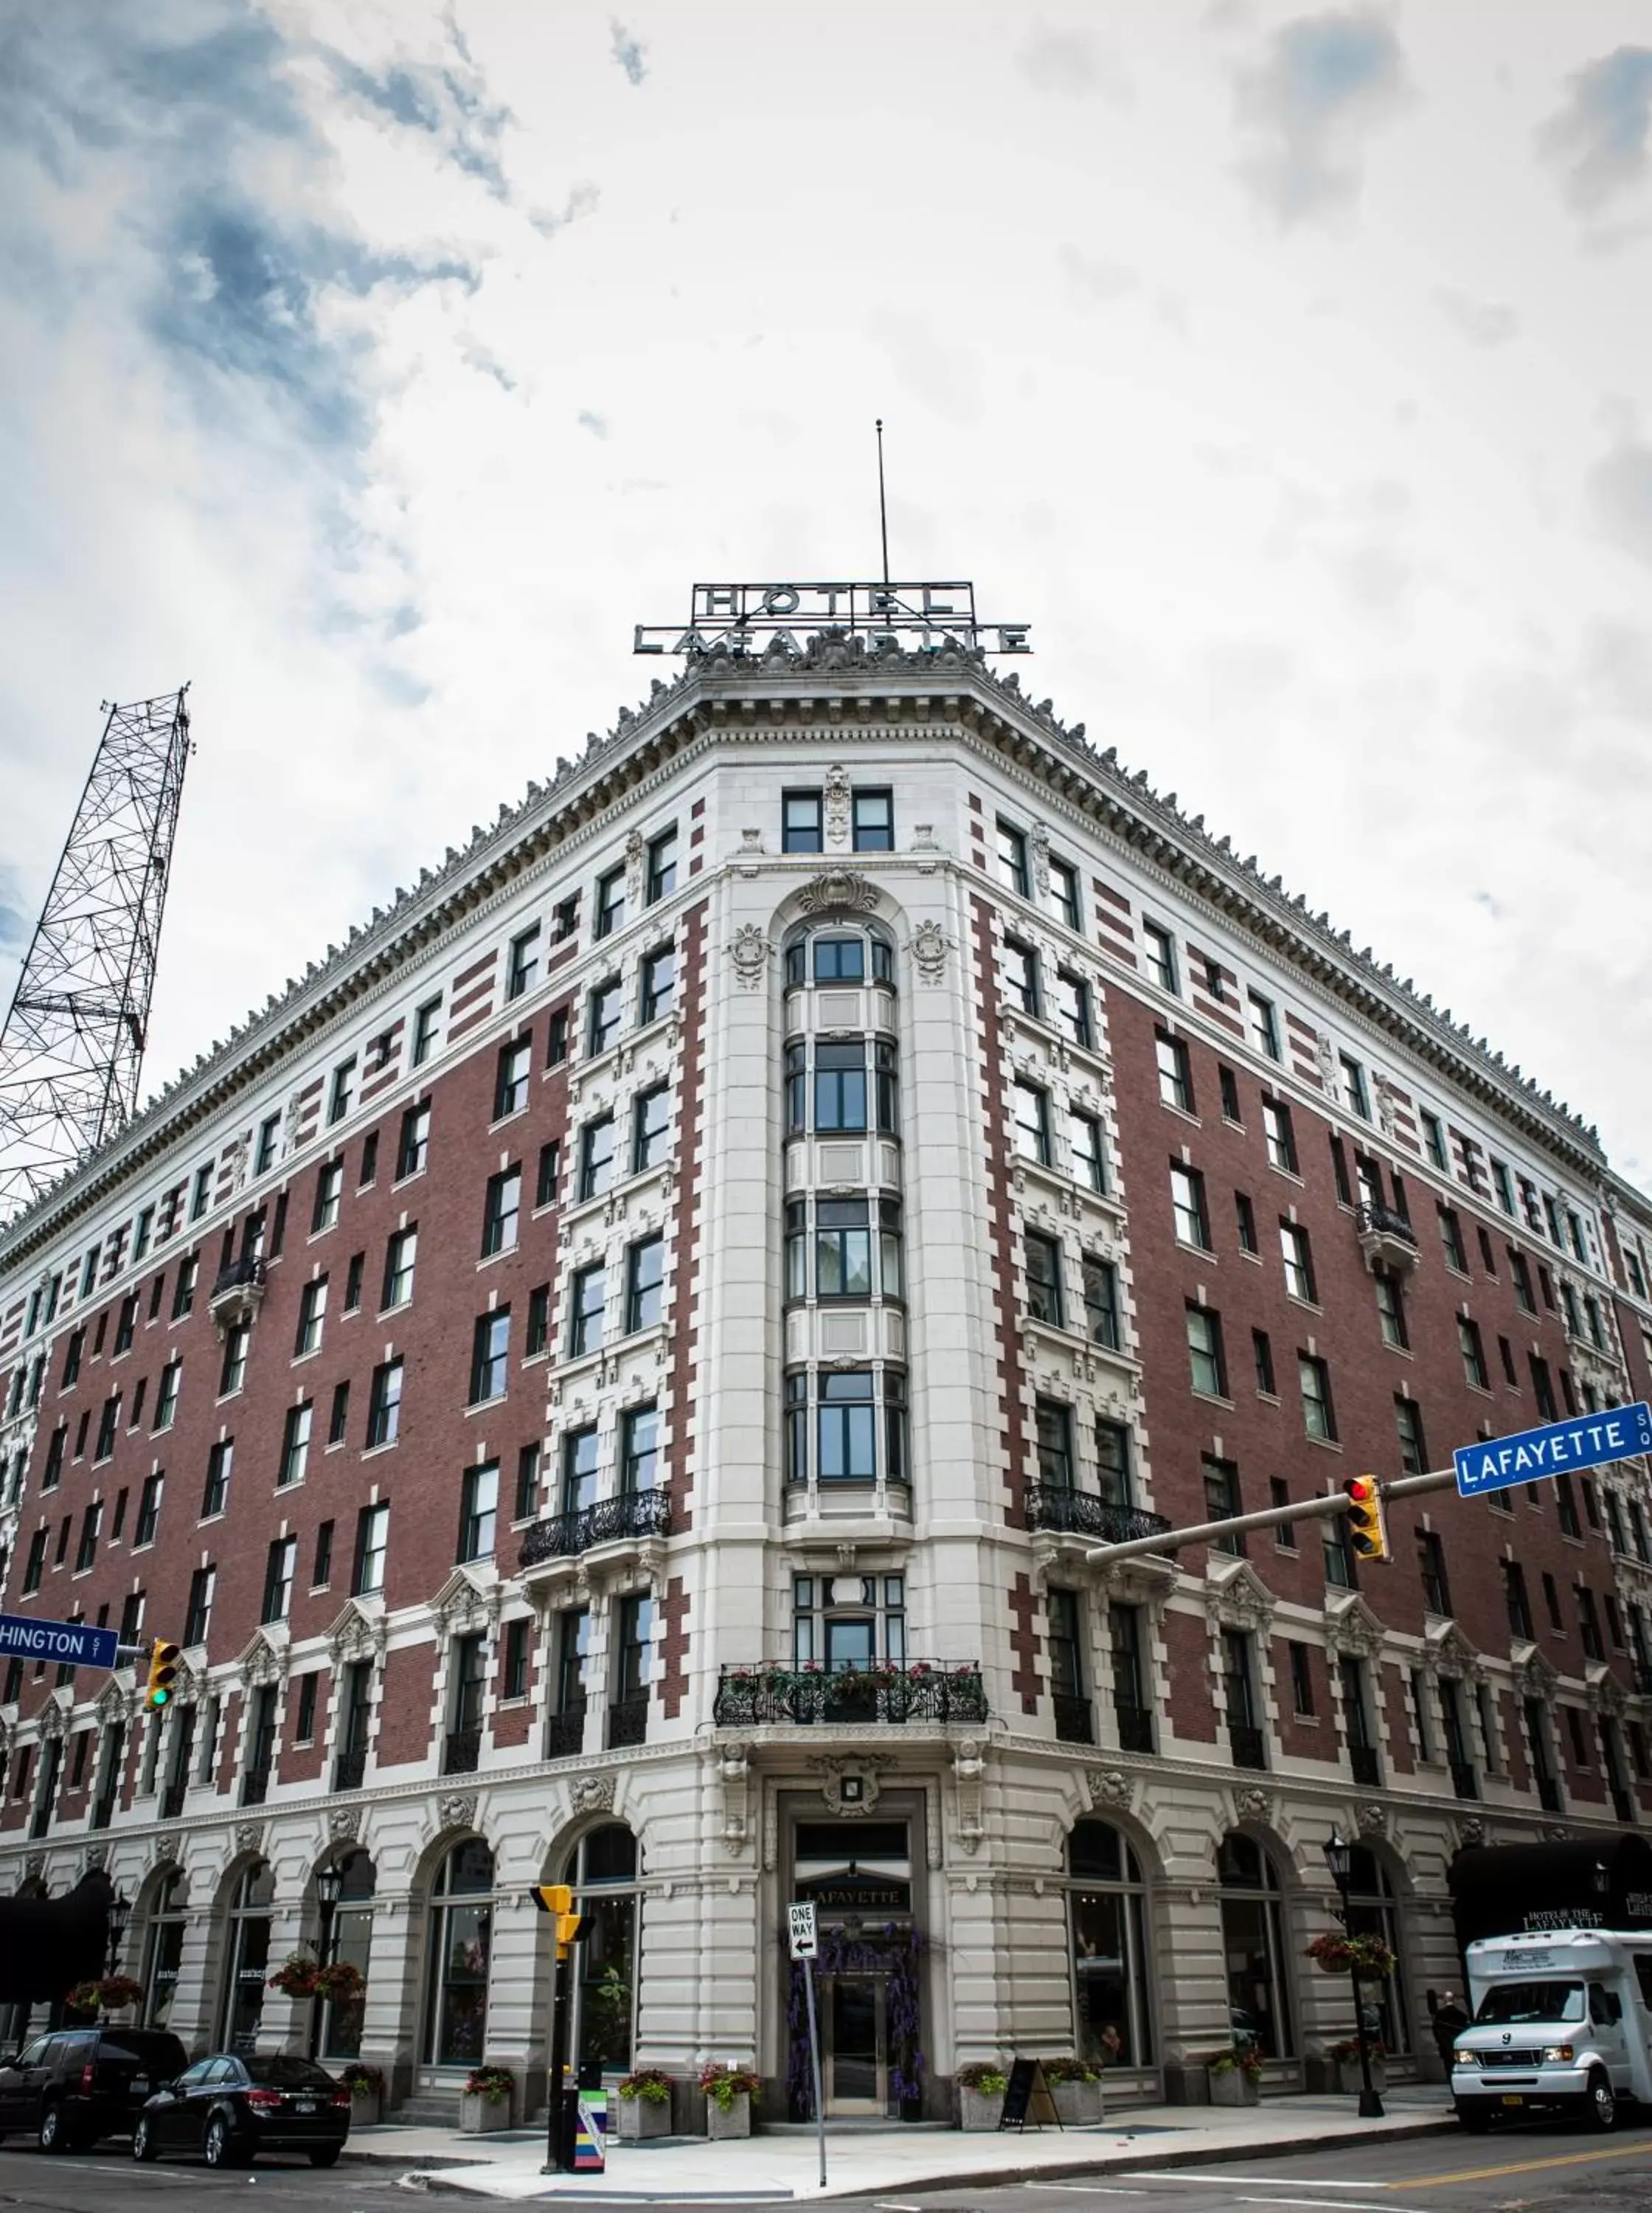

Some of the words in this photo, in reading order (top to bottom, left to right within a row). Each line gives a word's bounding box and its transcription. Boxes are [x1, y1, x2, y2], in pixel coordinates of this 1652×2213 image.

[706, 586, 954, 616] HOTEL
[634, 624, 1030, 654] LAFAETTE
[1461, 1421, 1625, 1483] LAFAYETTE
[1637, 1413, 1651, 1446] SQ
[0, 1625, 84, 1655] HINGTON
[91, 1637, 100, 1658] ST
[791, 1907, 811, 1921] ONE
[792, 1922, 813, 1936] WAY
[1502, 2032, 1511, 2045] 9
